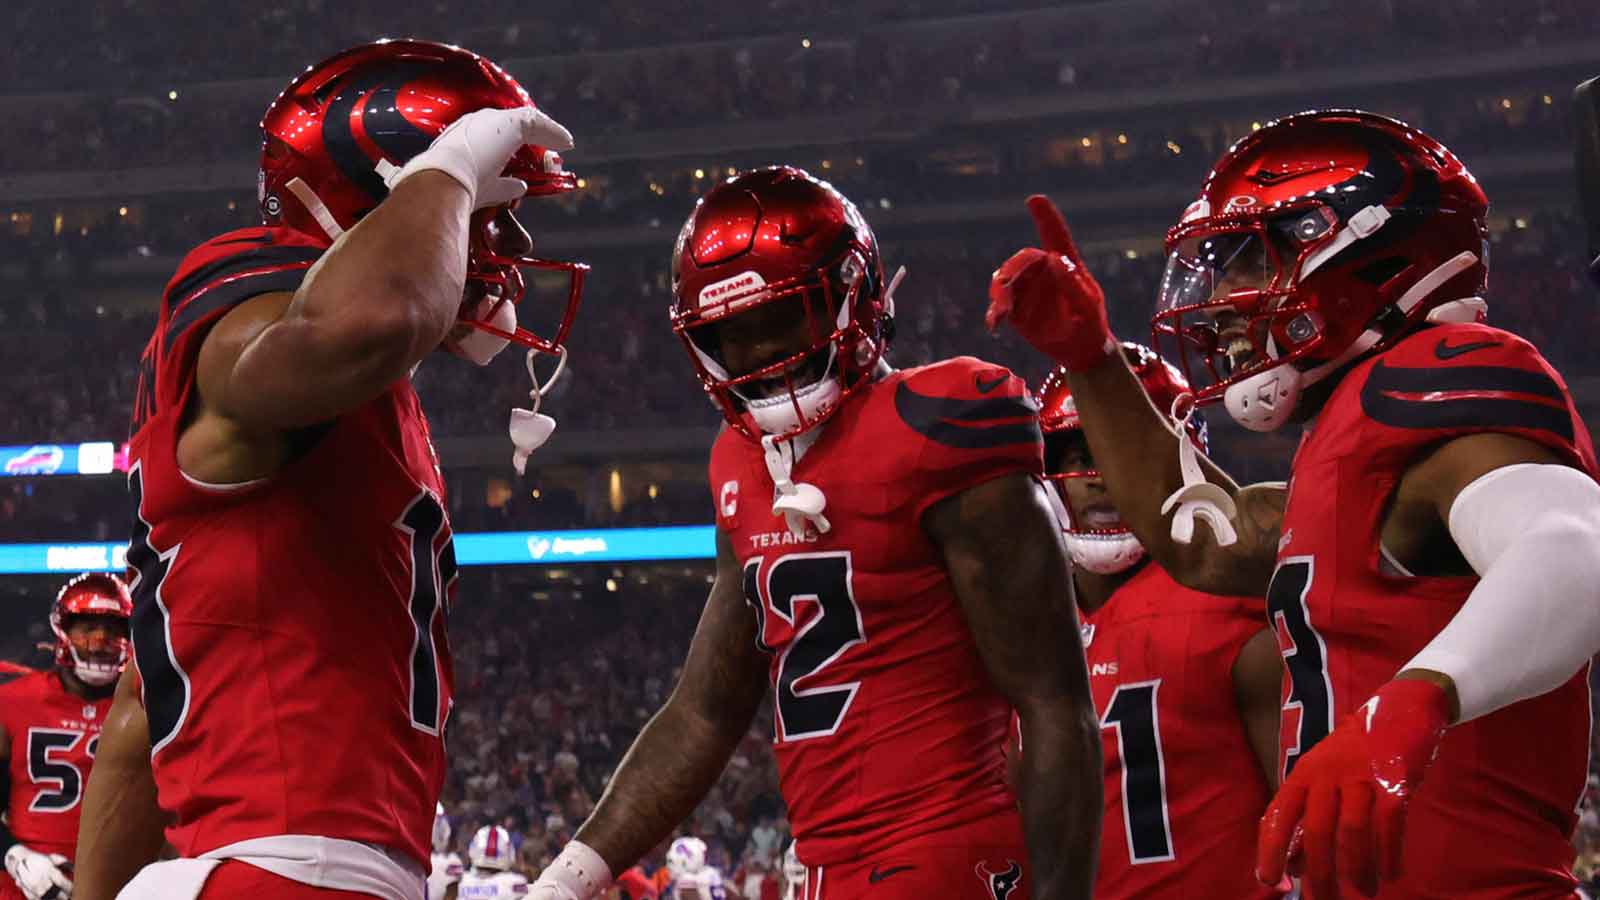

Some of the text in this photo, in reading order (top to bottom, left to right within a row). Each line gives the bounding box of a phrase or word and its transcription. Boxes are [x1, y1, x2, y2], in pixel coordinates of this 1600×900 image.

[703, 277, 753, 298] TEXANS
[720, 480, 738, 517] C
[743, 551, 866, 743] 12
